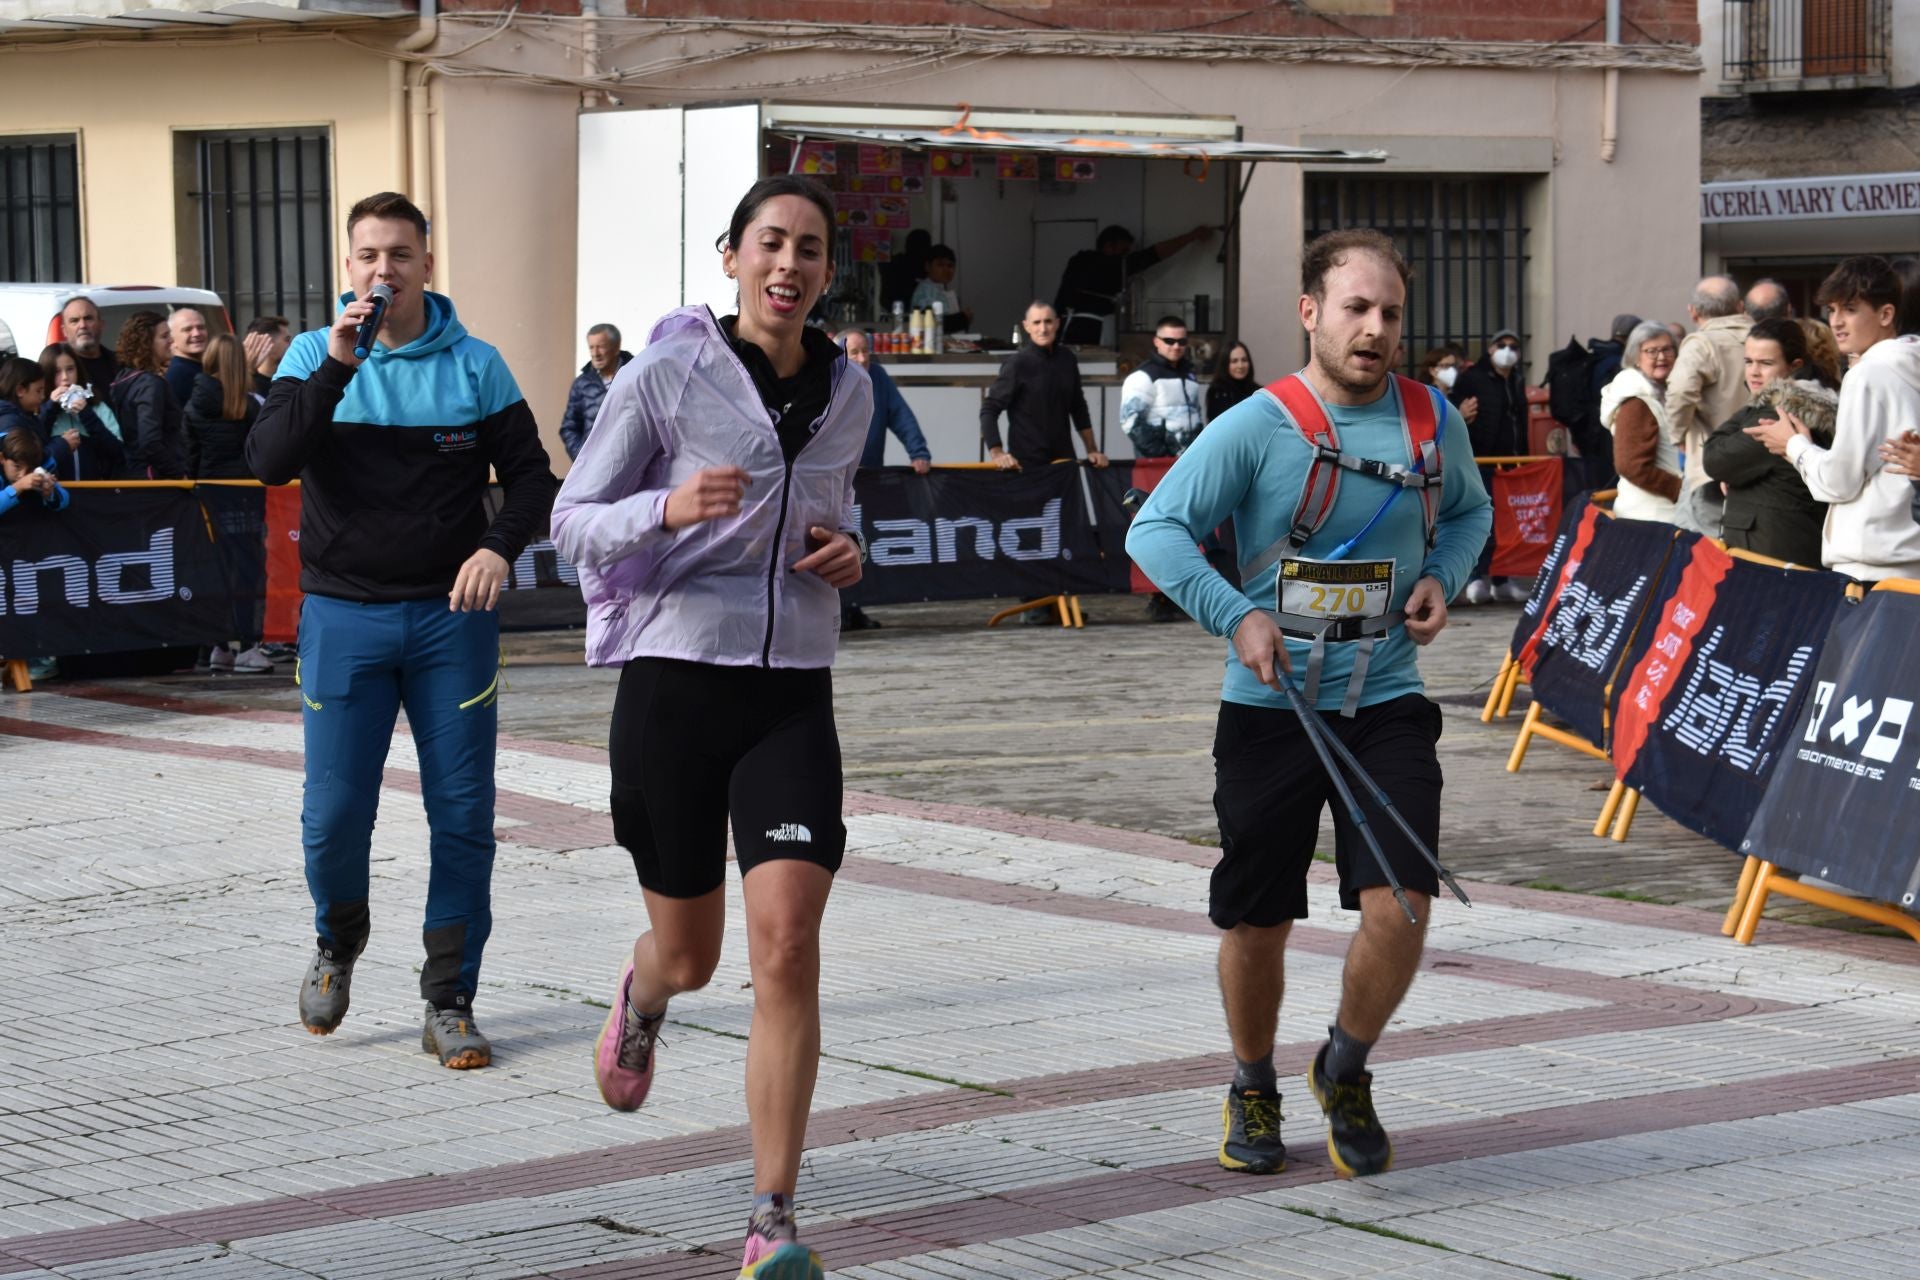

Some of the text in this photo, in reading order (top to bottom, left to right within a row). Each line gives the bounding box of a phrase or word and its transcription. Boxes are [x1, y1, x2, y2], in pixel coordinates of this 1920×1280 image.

[1776, 186, 1836, 215] MARY
[0, 527, 175, 616] nd
[1309, 586, 1365, 612] 270
[765, 828, 798, 839] NORTH
